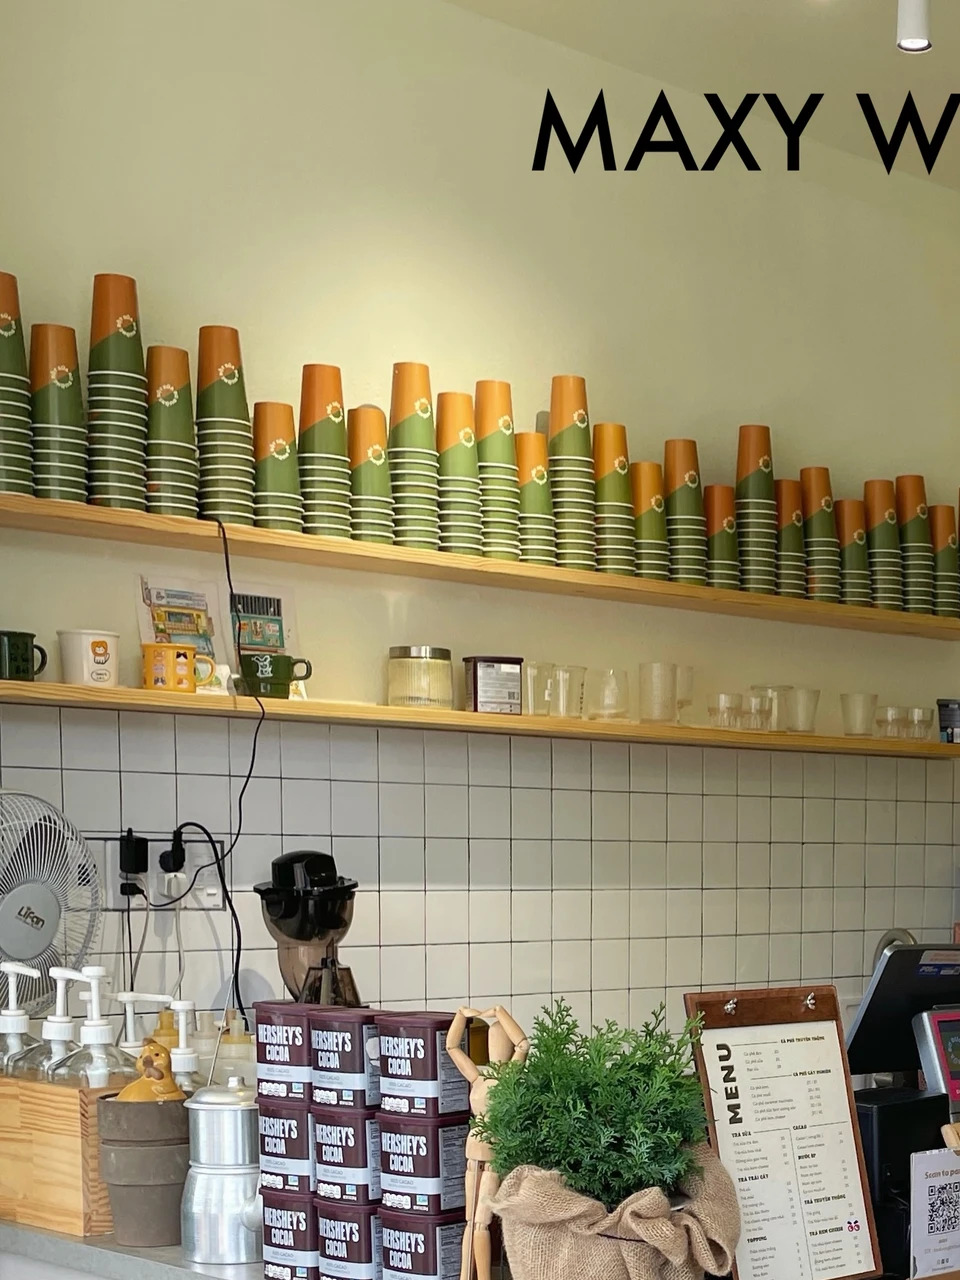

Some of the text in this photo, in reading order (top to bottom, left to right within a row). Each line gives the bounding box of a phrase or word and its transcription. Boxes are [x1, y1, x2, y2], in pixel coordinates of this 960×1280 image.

[258, 1024, 303, 1046] HERSHEY'S
[311, 1030, 351, 1052] HERSHEY'S
[266, 1045, 290, 1062] COCOA
[380, 1036, 424, 1059] HERSHEY'S
[318, 1051, 340, 1068] COCOA
[388, 1057, 412, 1076] COCOA
[716, 1043, 743, 1125] MENU
[315, 1123, 355, 1147] HERSHEY'S
[382, 1132, 427, 1157] HERSHEY'S
[265, 1136, 286, 1155] COCOA
[322, 1145, 344, 1163] COCOA
[390, 1154, 414, 1173] COCOA
[924, 1171, 941, 1179] Scan
[264, 1207, 306, 1231] HERSHEY'S
[271, 1228, 294, 1247] COCOA
[319, 1217, 360, 1242] HERSHEY'S
[325, 1239, 347, 1258] COCOA
[383, 1227, 425, 1254] HERSHEY'S
[390, 1250, 412, 1270] COCOA
